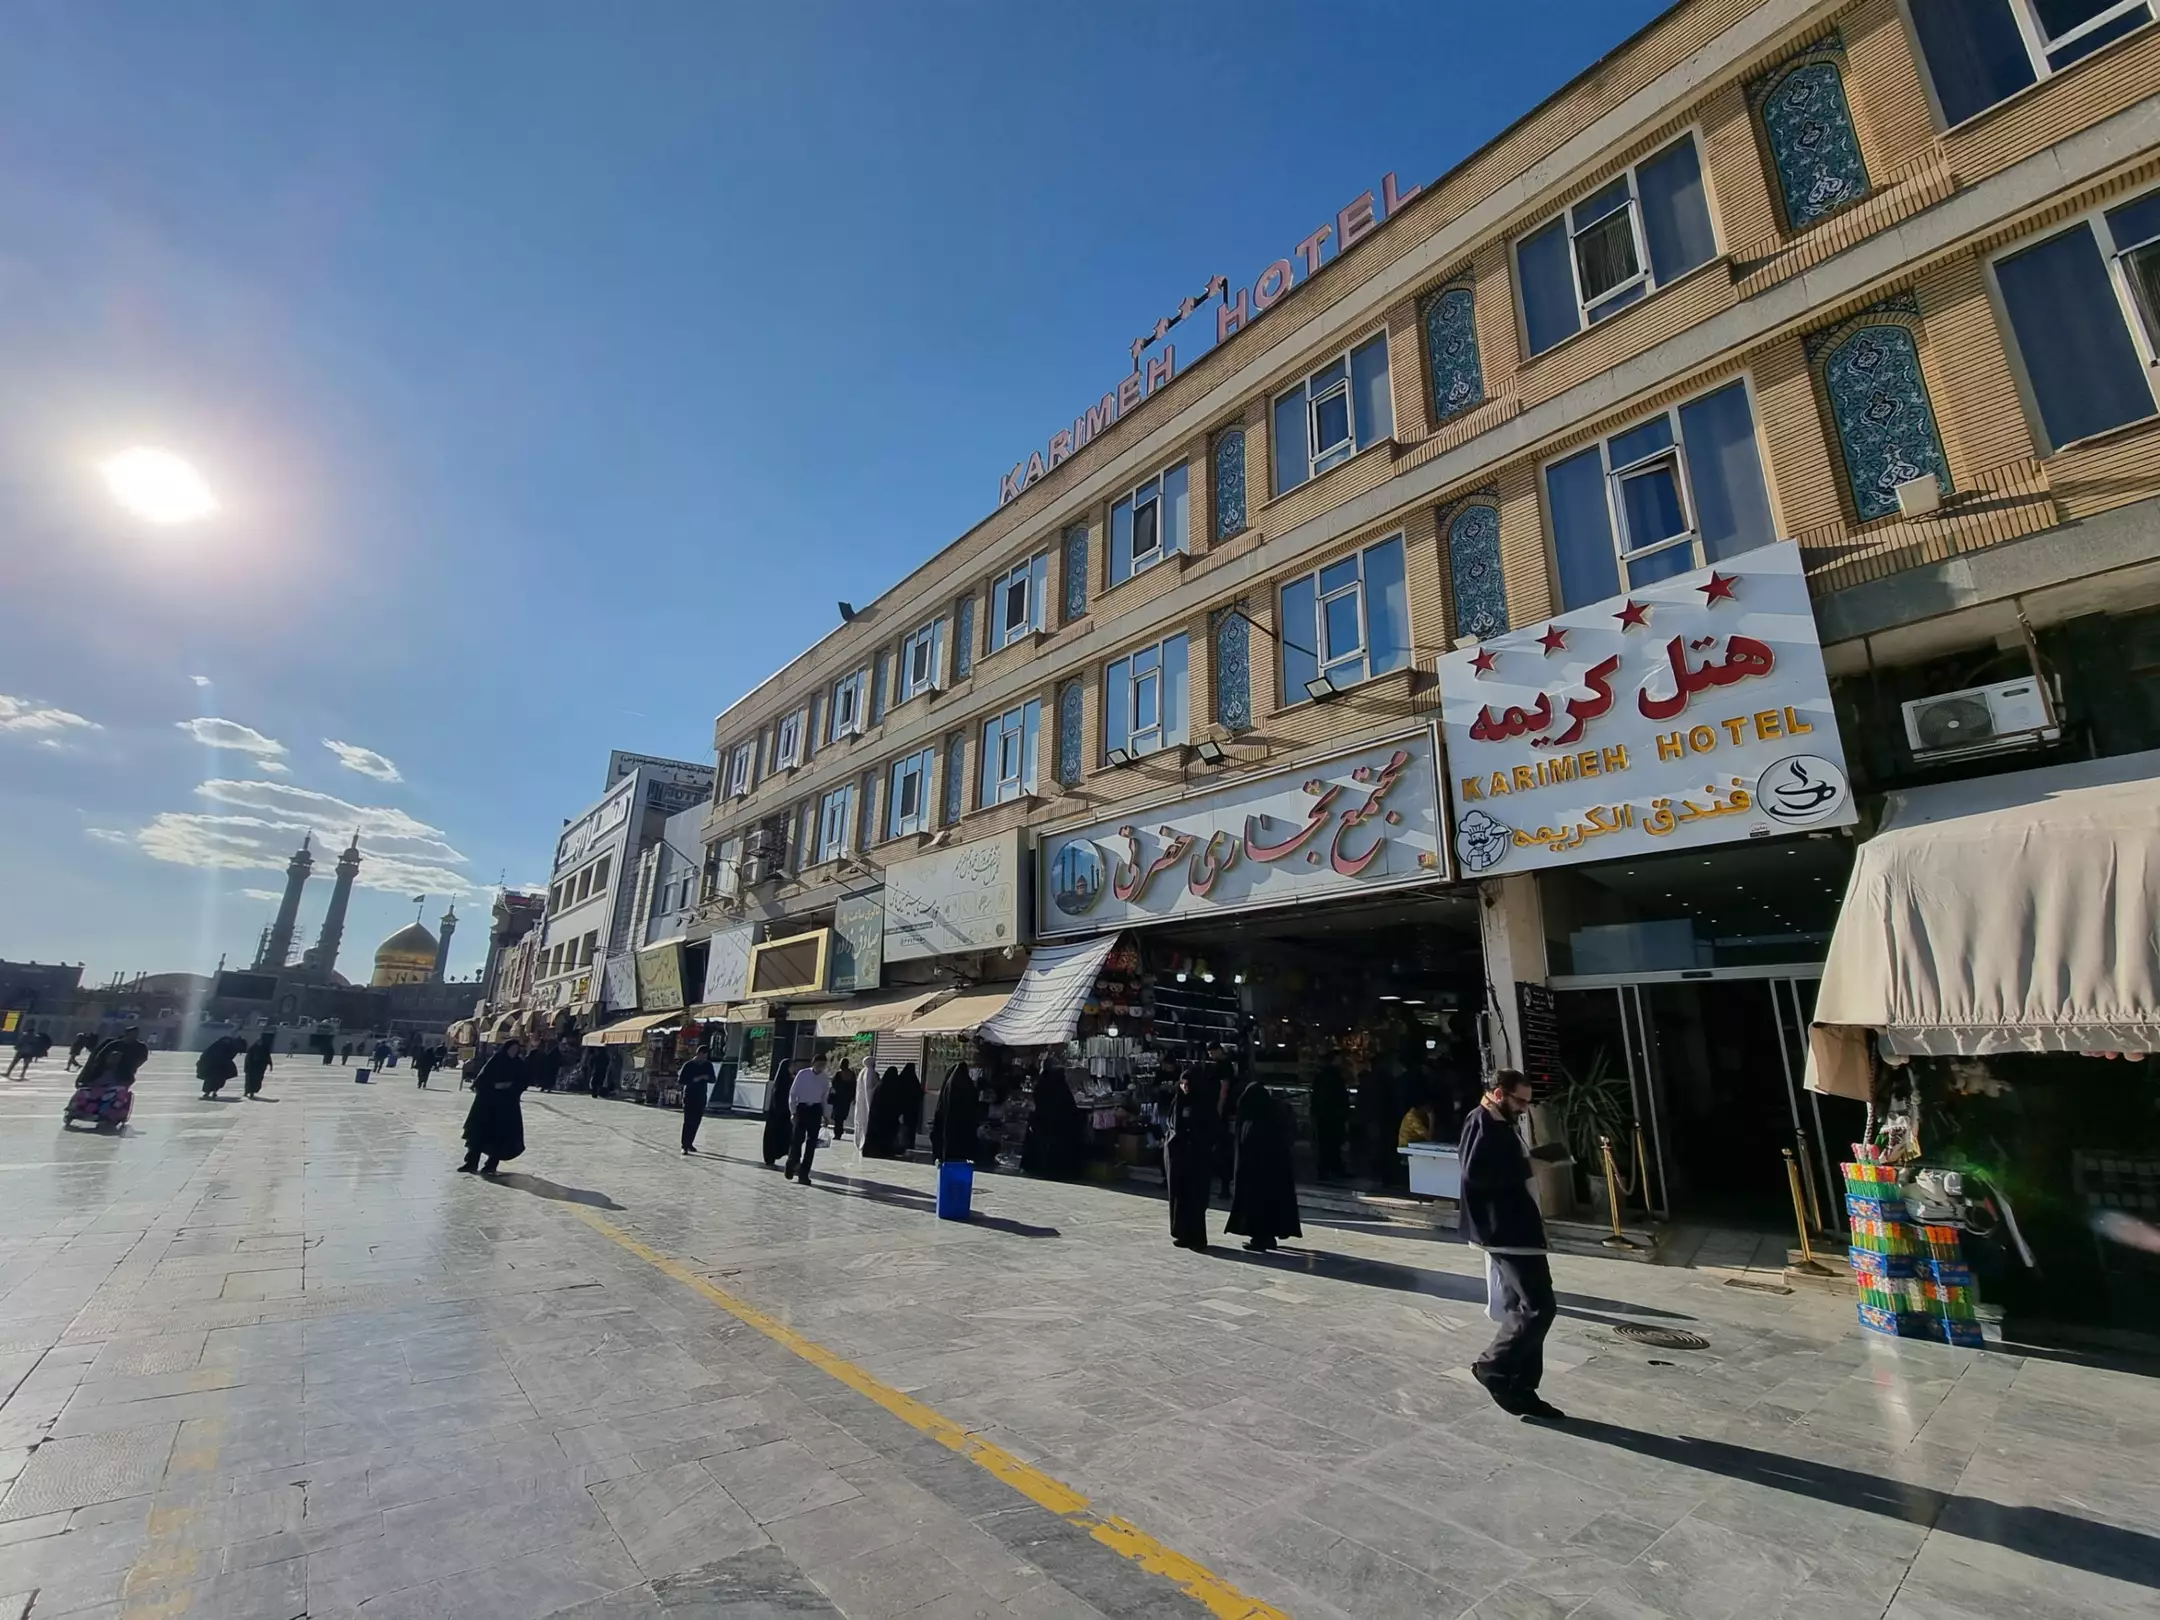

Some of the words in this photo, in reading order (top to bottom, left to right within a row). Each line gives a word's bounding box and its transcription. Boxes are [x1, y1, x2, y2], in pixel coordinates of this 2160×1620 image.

[999, 344, 1176, 505] KARIMEH
[1216, 171, 1423, 344] HOTEL
[1469, 654, 1620, 748] کریمه
[1638, 635, 1775, 720] هتل
[1461, 743, 1630, 803] KARIMEH
[1655, 705, 1813, 763] HOTEL
[1188, 778, 1342, 898] تجاری
[1330, 750, 1408, 877] مجتمع
[1642, 777, 1752, 837] فندق
